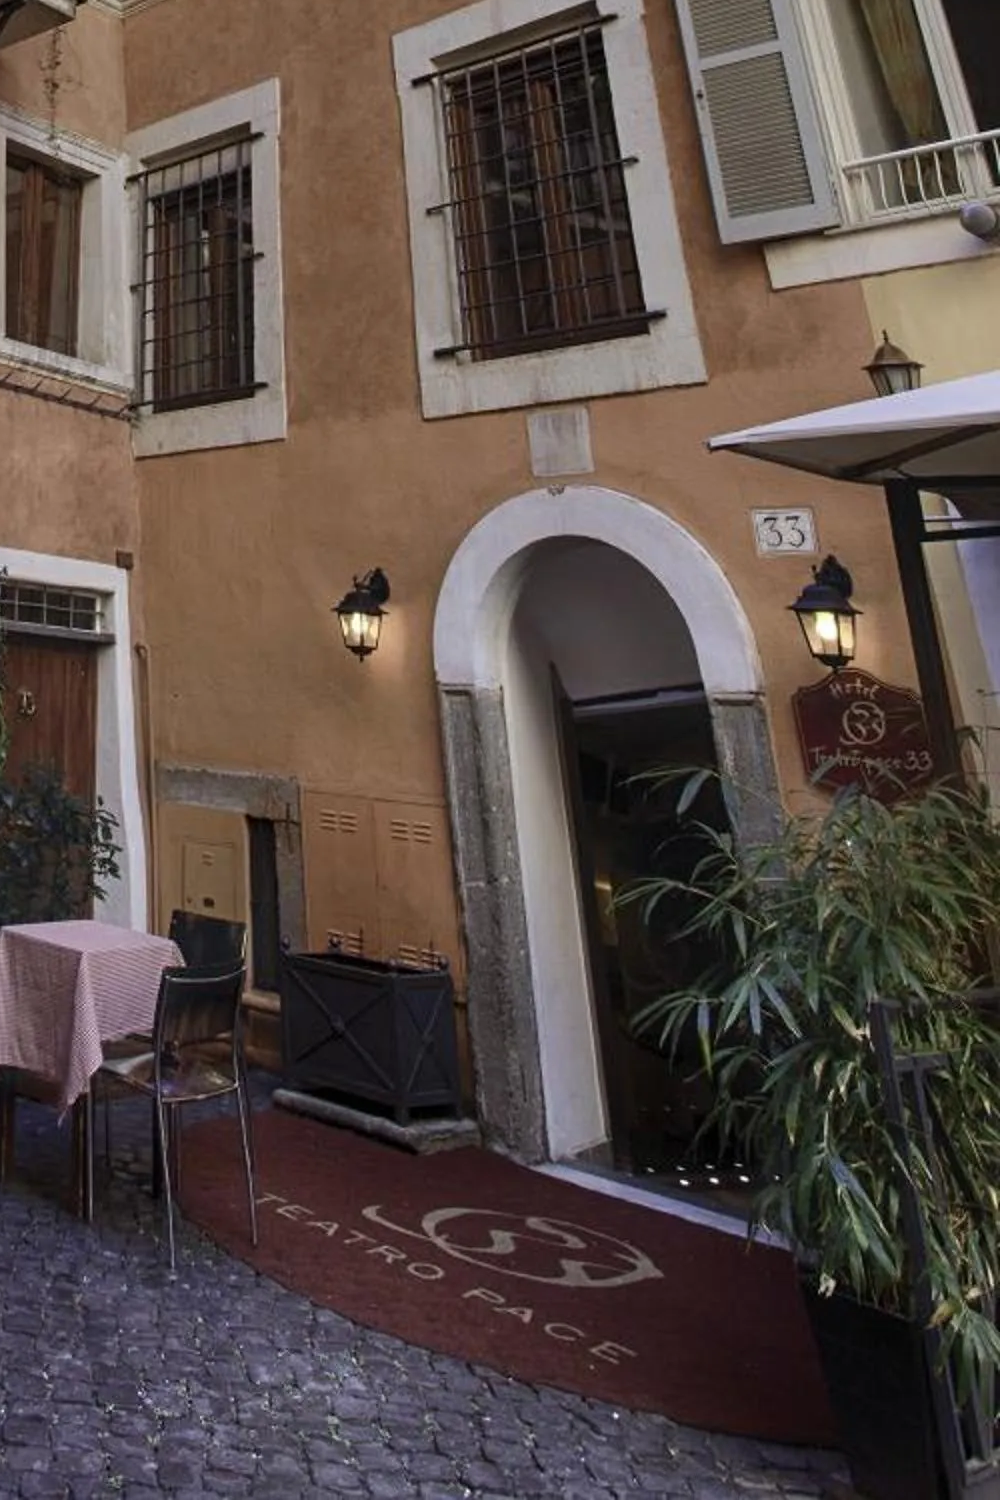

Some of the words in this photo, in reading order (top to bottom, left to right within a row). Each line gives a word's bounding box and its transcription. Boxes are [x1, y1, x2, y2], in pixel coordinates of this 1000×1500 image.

[763, 515, 805, 548] 33
[904, 750, 933, 771] 33
[255, 1192, 446, 1281] TEATRO
[462, 1286, 639, 1365] PACE
